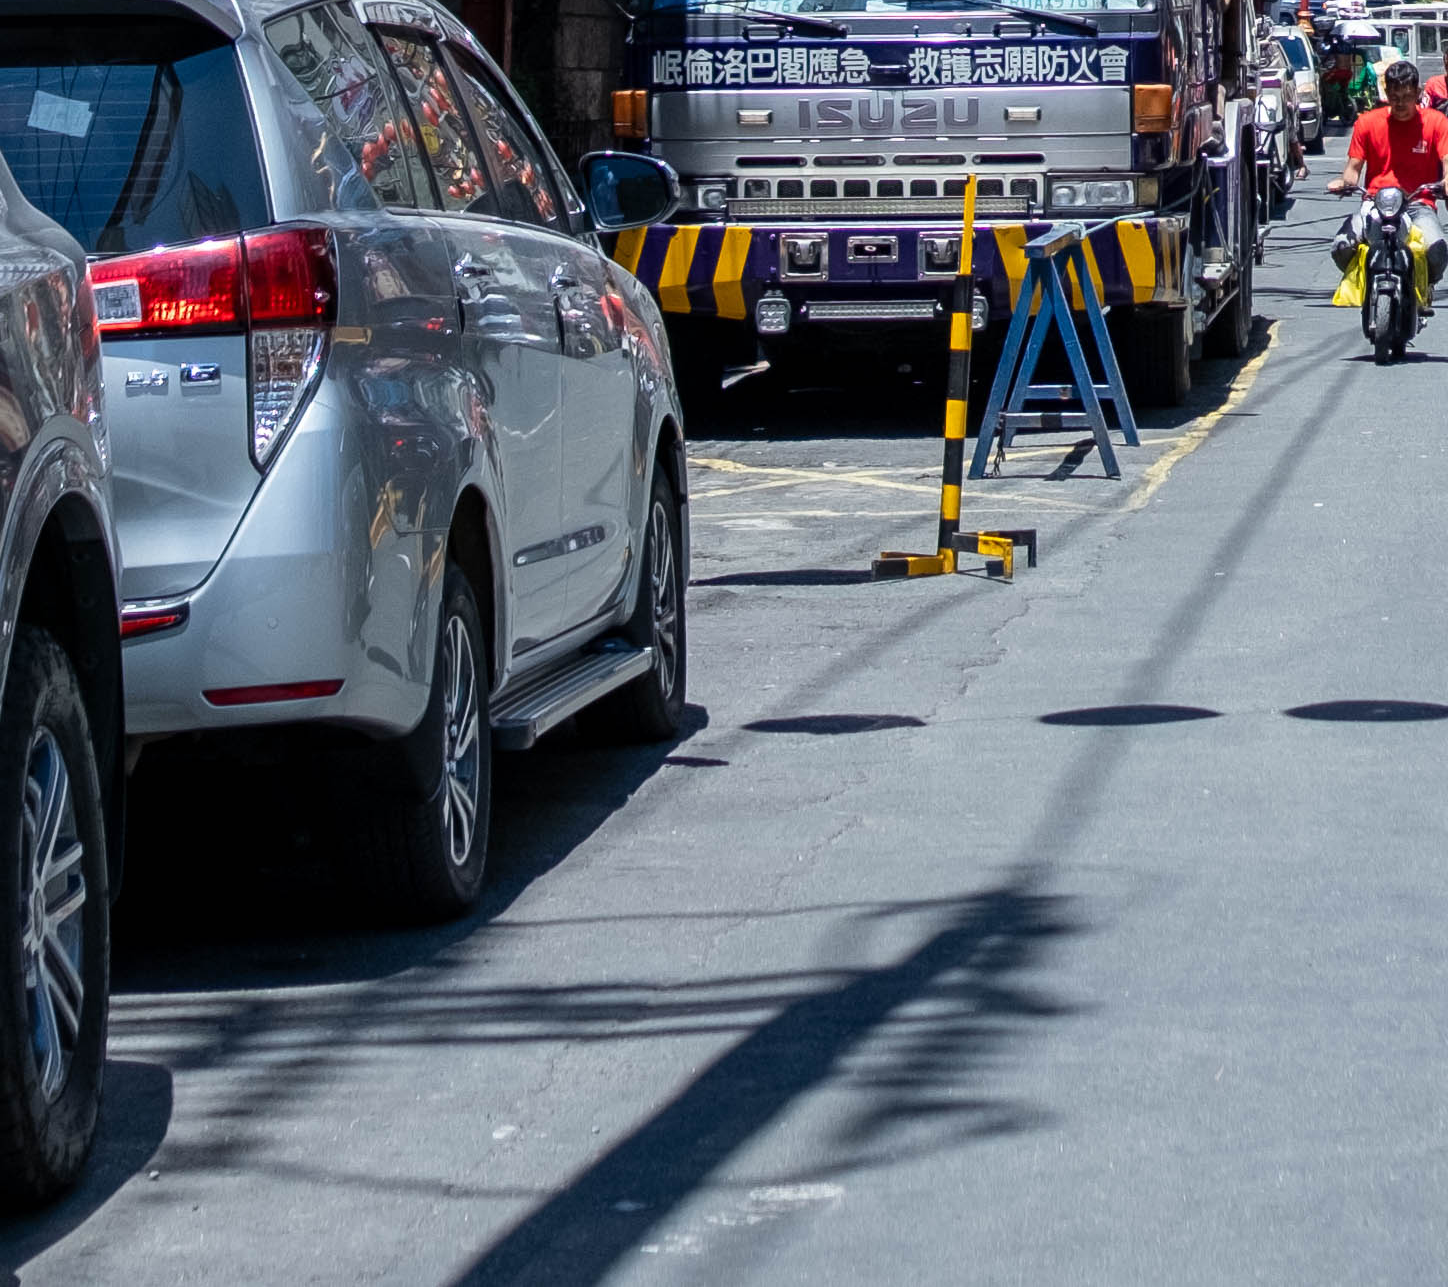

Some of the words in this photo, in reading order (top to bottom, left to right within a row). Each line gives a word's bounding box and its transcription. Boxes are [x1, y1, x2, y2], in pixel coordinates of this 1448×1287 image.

[652, 47, 871, 86] 岷倫洛巴閣應急
[909, 45, 1129, 85] 救護志願防火會
[797, 96, 980, 131] ISUZU
